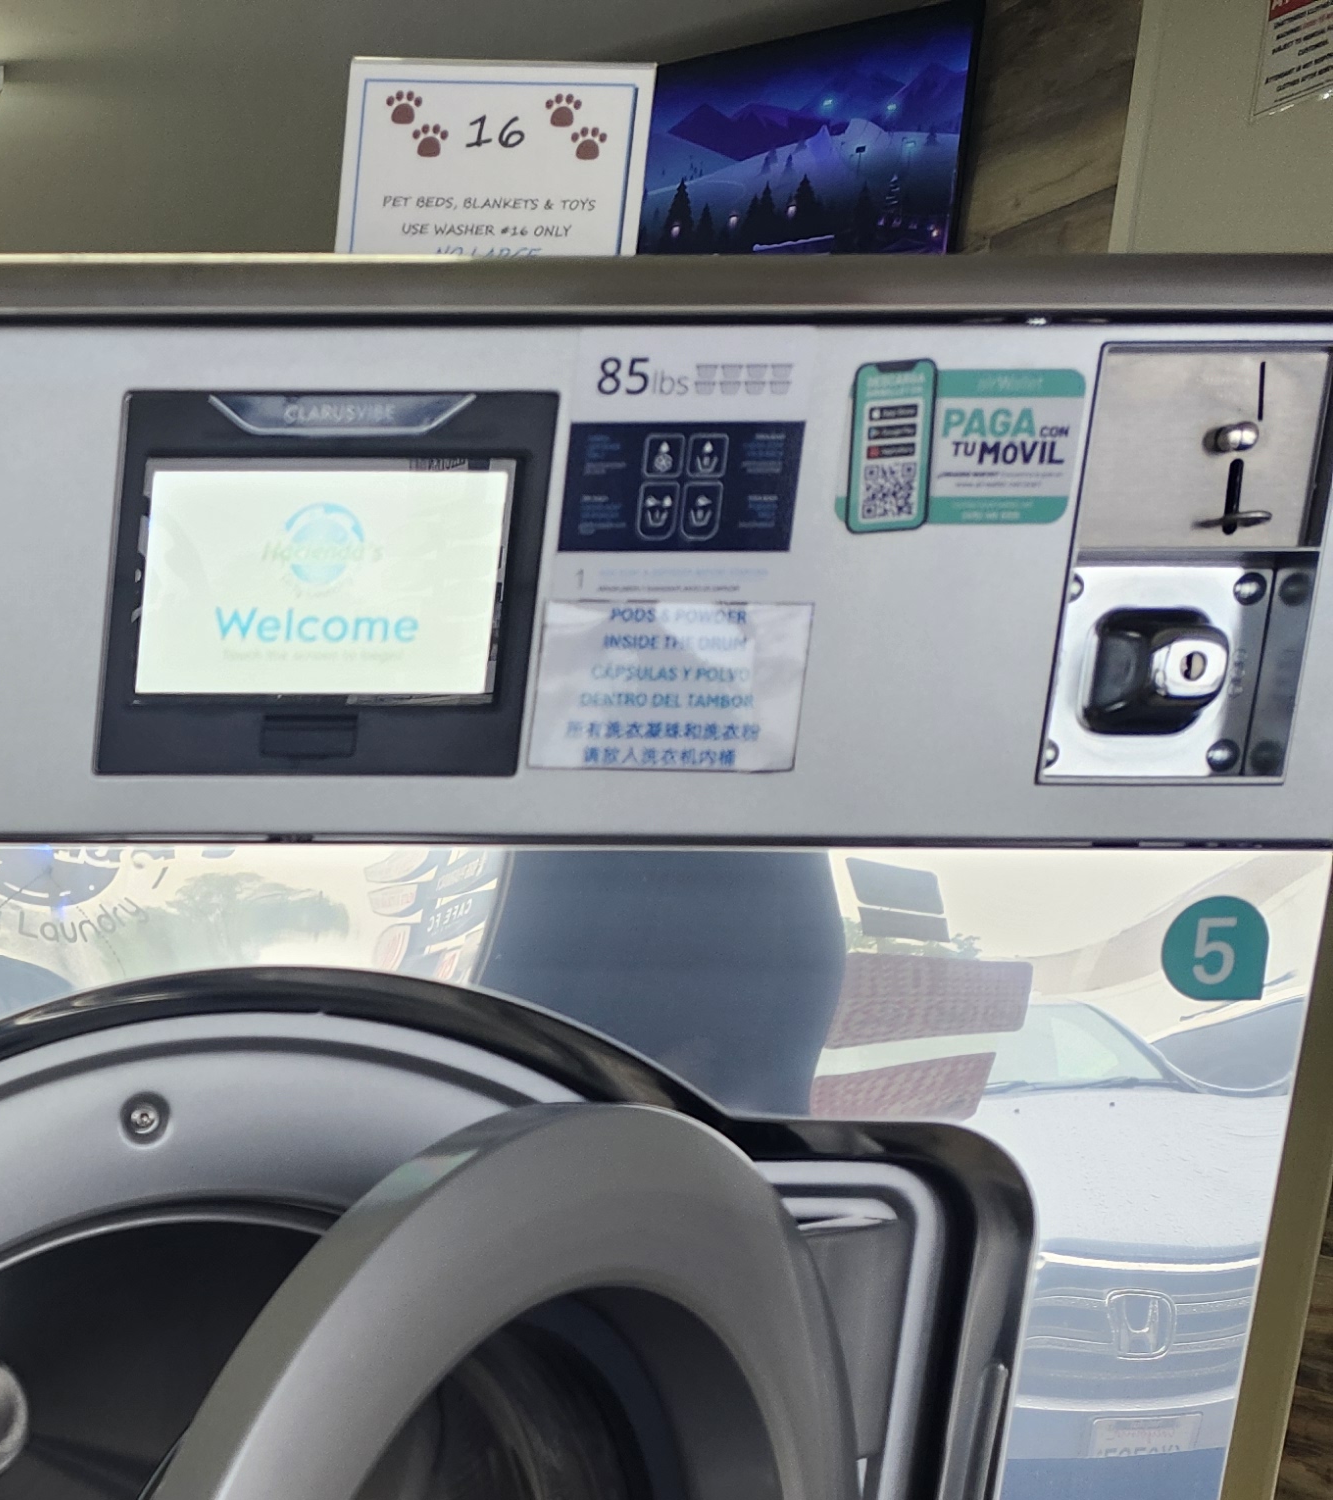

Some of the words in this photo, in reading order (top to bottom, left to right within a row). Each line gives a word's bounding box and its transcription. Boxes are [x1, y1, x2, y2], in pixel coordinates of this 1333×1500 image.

[465, 114, 525, 148] 16
[382, 195, 413, 208] PET
[416, 196, 458, 210] BEDS,
[463, 197, 539, 211] BLANKETS
[544, 199, 554, 210] &
[561, 198, 597, 211] TOYS
[402, 223, 429, 235] USE
[434, 223, 495, 236] WASHER
[501, 224, 528, 236] #16
[533, 224, 572, 237] ONLY
[941, 407, 1036, 438] PAGA
[1039, 426, 1070, 438] CON
[952, 440, 976, 457] TU
[609, 607, 656, 623] PODS
[675, 608, 746, 623] POWDER
[215, 606, 419, 643] Welcome
[603, 634, 659, 649] INSIDE
[664, 636, 696, 650] THE
[699, 635, 747, 650] DRUM
[682, 667, 691, 681] Y
[696, 667, 750, 682] POLVO
[580, 693, 647, 708] DENTRO
[652, 694, 680, 708] DEL
[687, 694, 755, 709] TAMBOR
[18, 896, 149, 944] Laundry
[1192, 916, 1238, 986] 5
